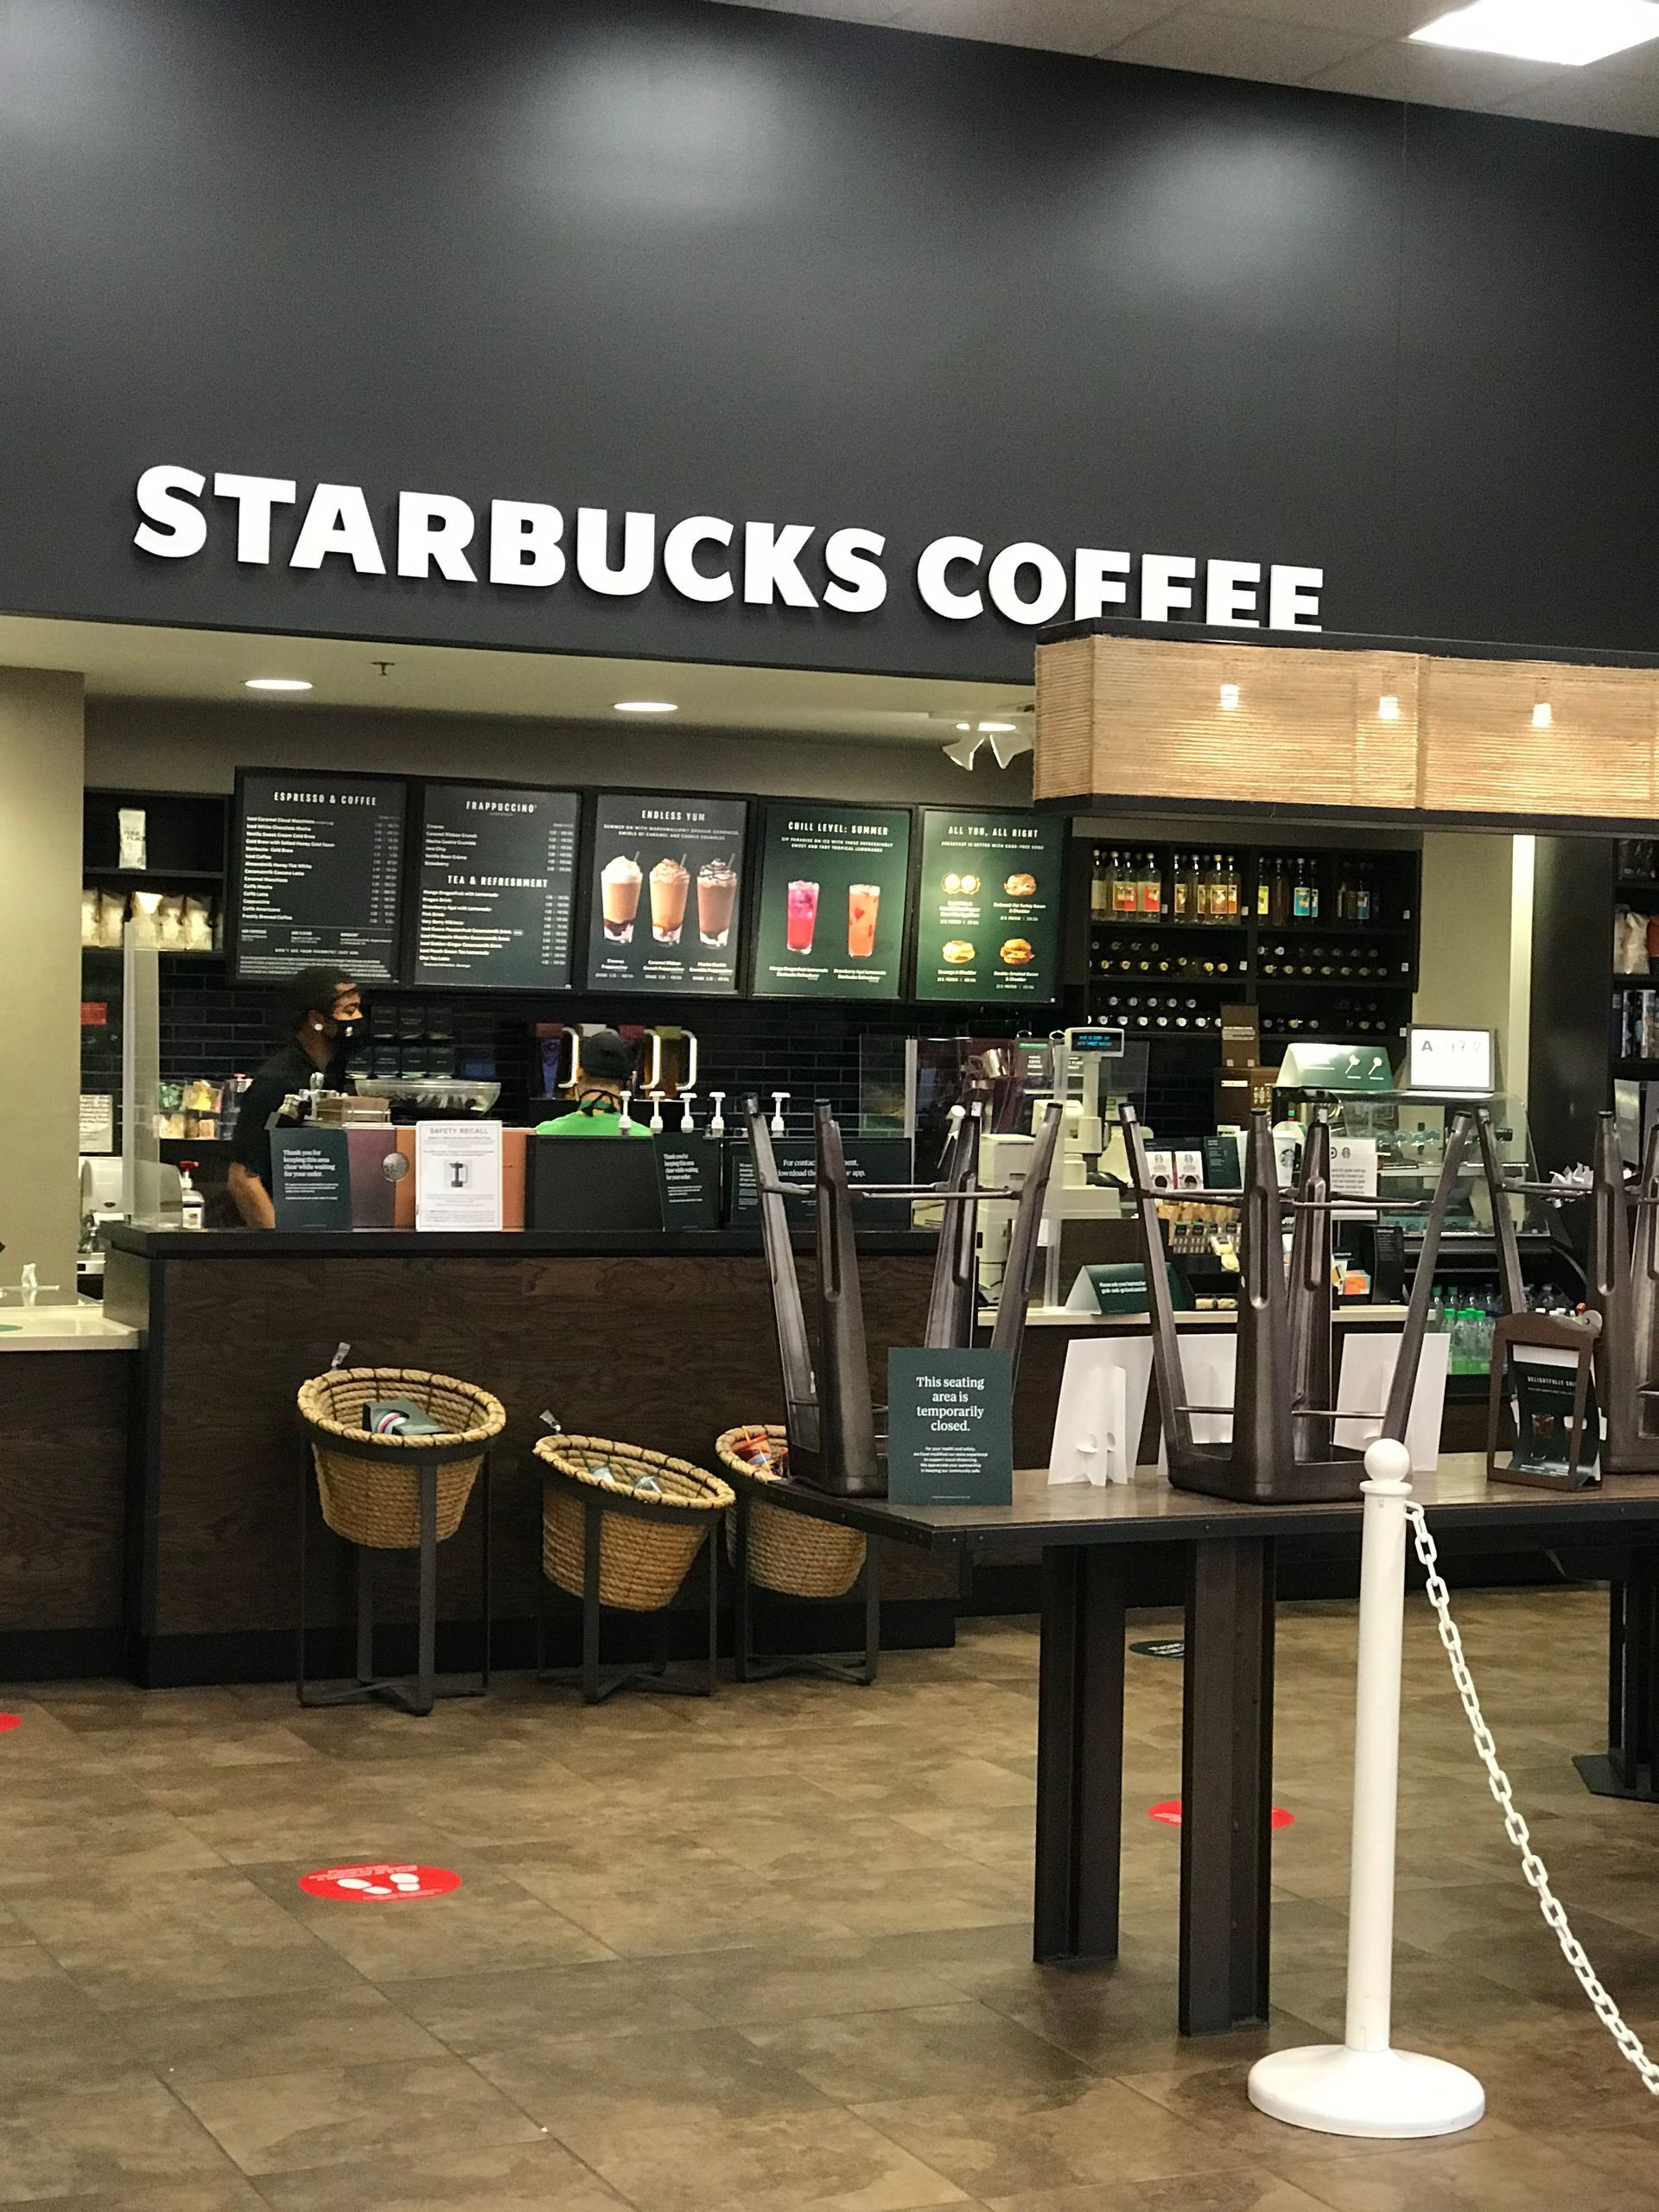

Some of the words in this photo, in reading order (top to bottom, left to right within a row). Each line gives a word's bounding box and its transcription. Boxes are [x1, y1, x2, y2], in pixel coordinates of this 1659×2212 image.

[133, 465, 887, 613] STARBUCKS
[916, 535, 1324, 632] COFFEE
[274, 791, 325, 803] ESPRESSO
[329, 795, 336, 804] &
[340, 795, 377, 806] COFFEE
[641, 810, 682, 820] ENDLESS
[686, 812, 705, 821] YUM
[788, 822, 814, 830] CHILL
[817, 823, 847, 833] LEVEL:
[851, 825, 888, 836] SUMMER
[948, 826, 963, 835] ALL
[992, 828, 1007, 836] ALL
[1012, 829, 1039, 838] RIGHT
[448, 875, 465, 884] TEA
[469, 876, 476, 885] &
[480, 877, 548, 887] REFRESHMENT
[1421, 1040, 1433, 1052] A
[916, 1376, 942, 1388] This
[943, 1376, 985, 1390] seating
[931, 1393, 957, 1402] area
[959, 1391, 969, 1402] is
[916, 1405, 985, 1419] temporarily
[931, 1420, 970, 1431] closed.
